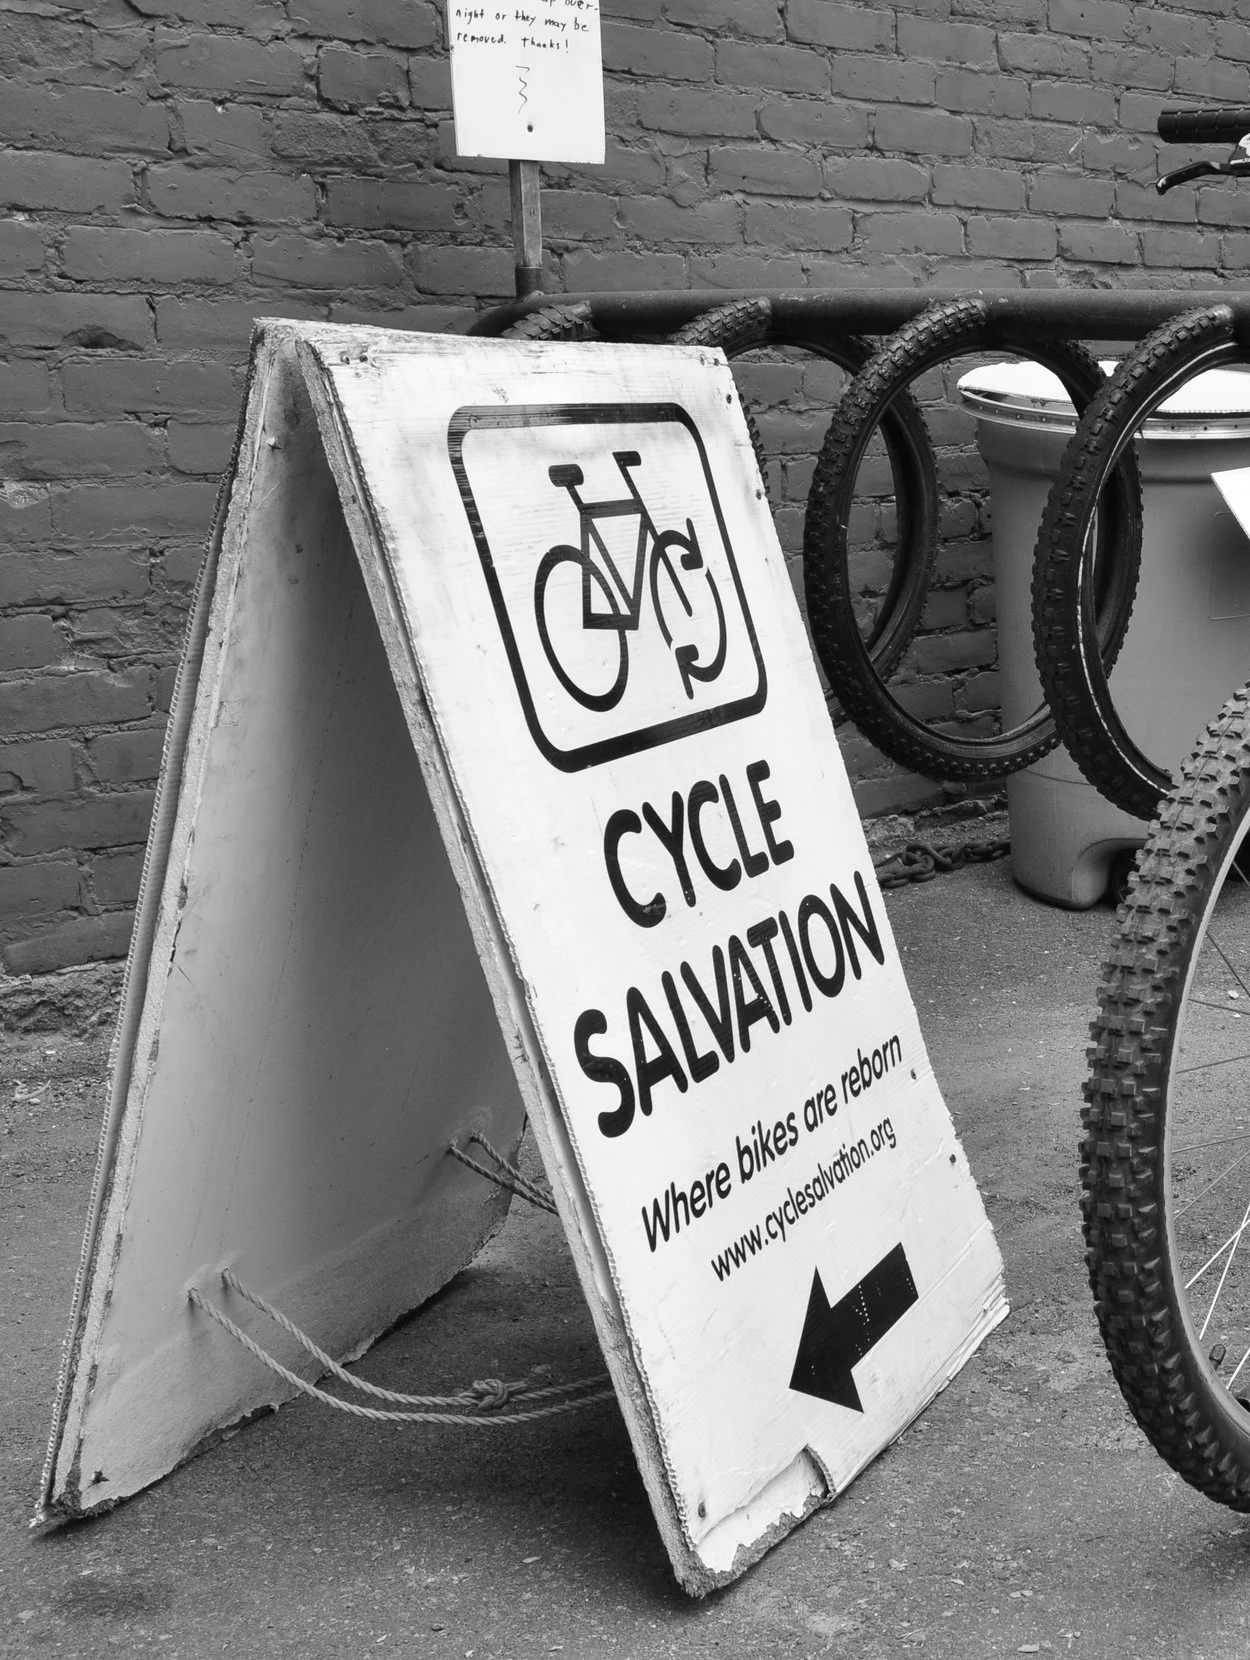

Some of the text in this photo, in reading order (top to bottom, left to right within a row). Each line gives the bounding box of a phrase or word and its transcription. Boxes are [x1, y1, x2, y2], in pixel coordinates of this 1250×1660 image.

[455, 8, 590, 32] night or they may be
[456, 31, 507, 44] removed.
[603, 759, 795, 929] CYCLE
[573, 870, 886, 1139] SALVATION
[641, 1034, 902, 1253] Where bikes are reborn
[710, 1117, 897, 1282] www.cyclesalvation.org
